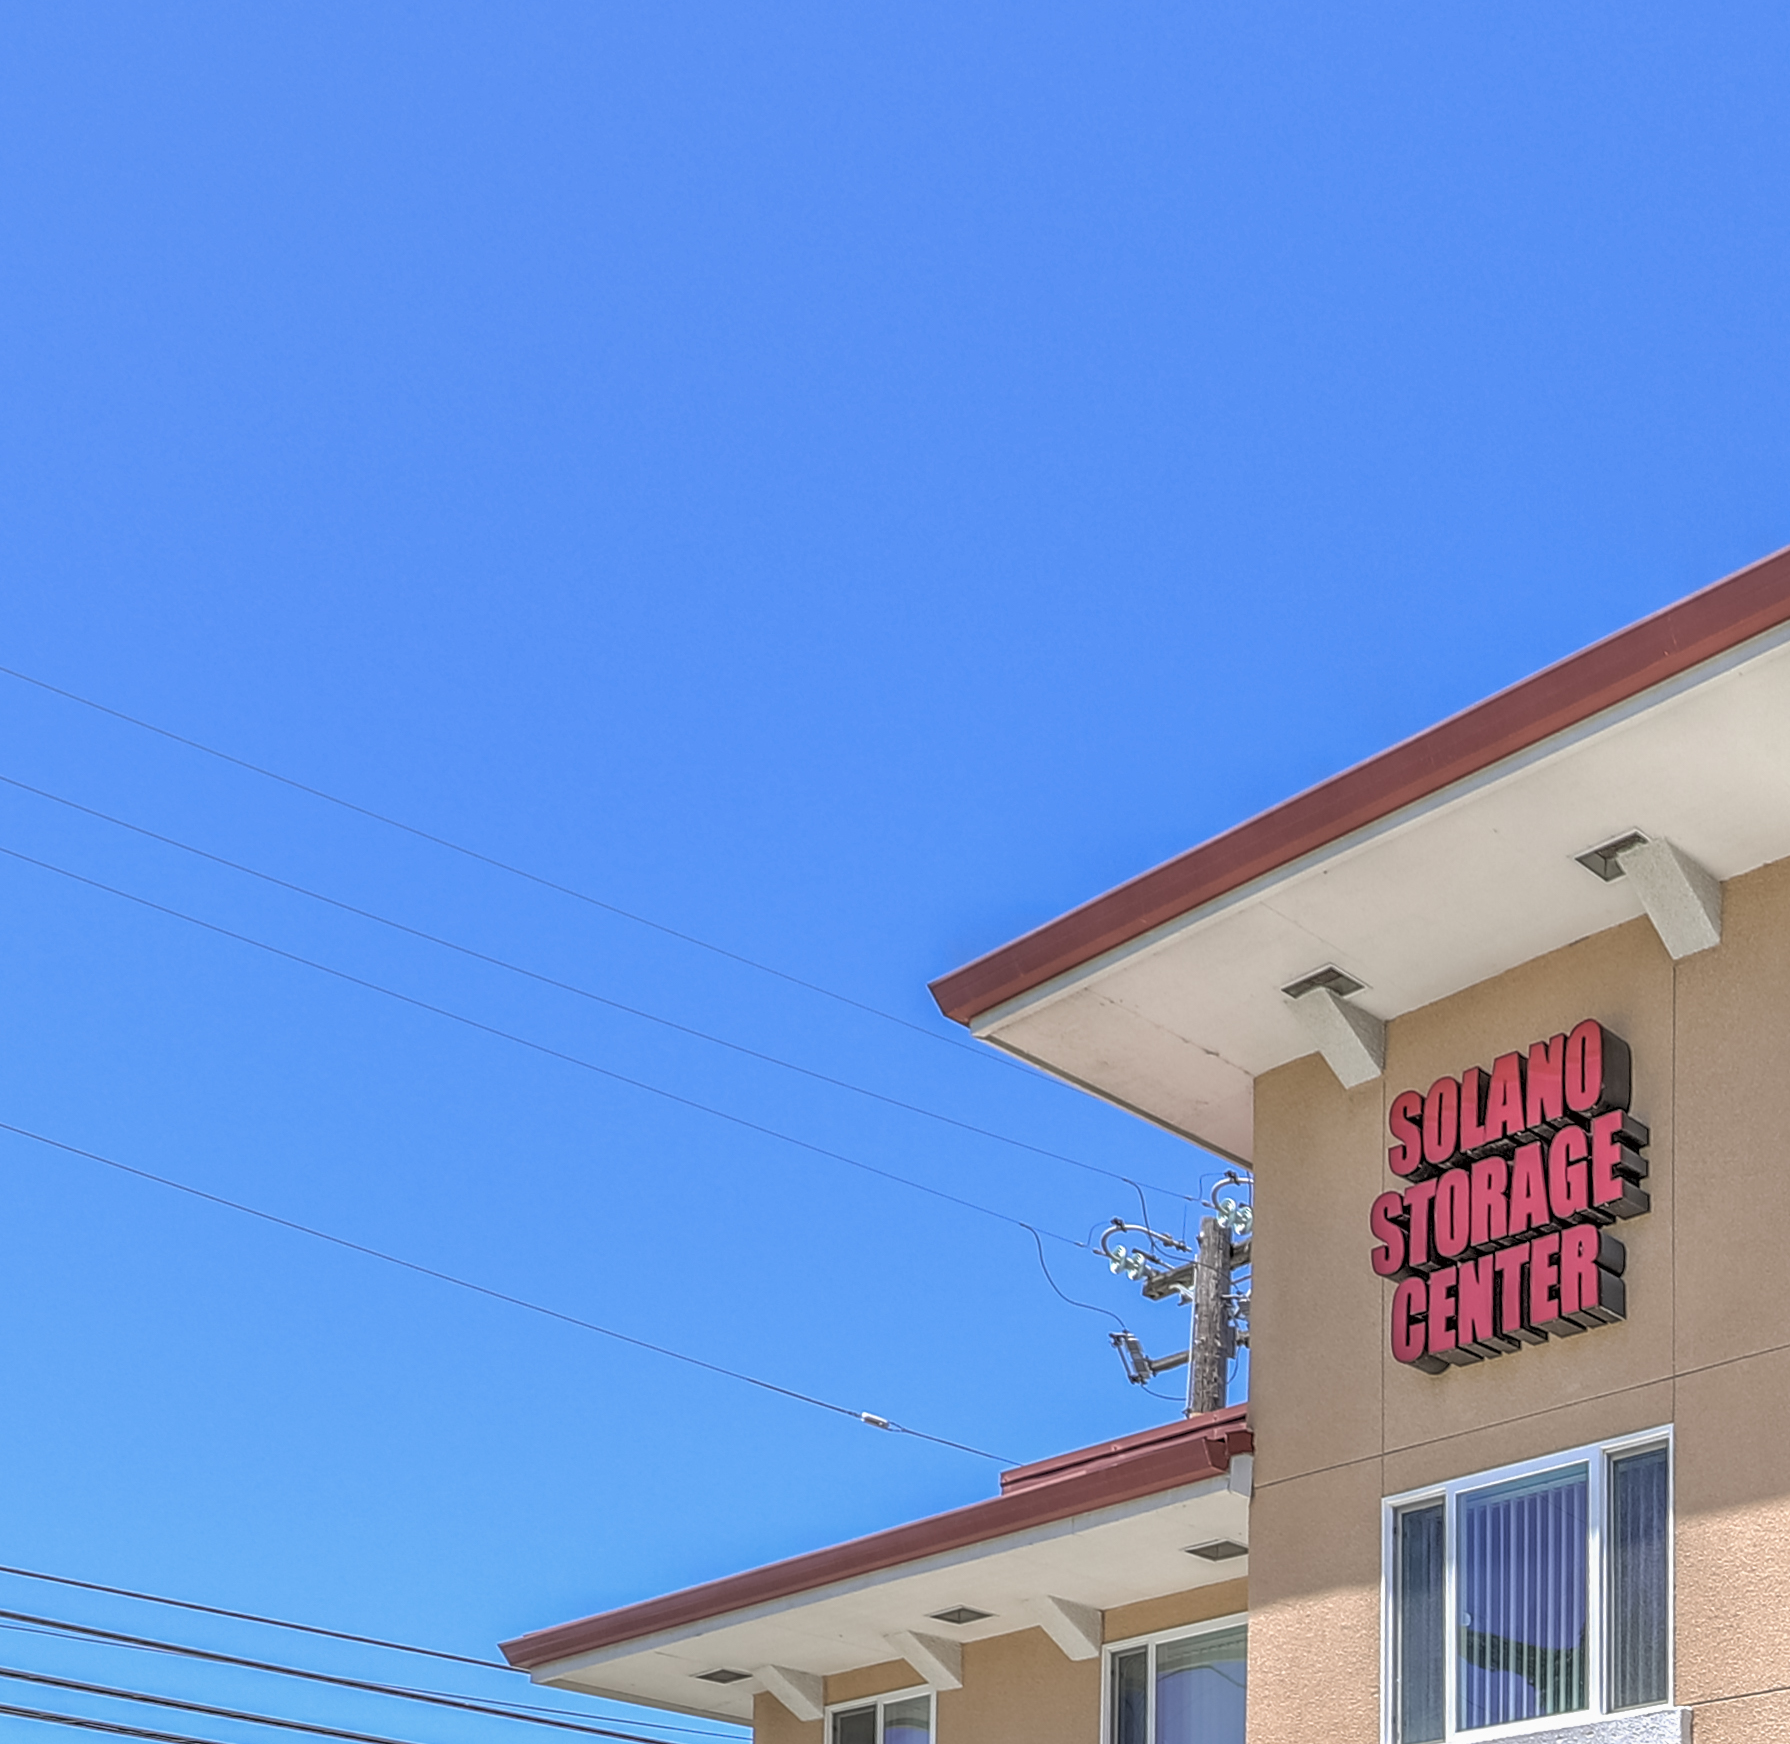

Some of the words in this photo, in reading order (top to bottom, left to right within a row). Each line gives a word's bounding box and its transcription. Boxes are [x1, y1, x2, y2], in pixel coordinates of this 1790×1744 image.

[1388, 1018, 1603, 1176] SOLANO
[1370, 1109, 1624, 1276] STORAGE
[1391, 1223, 1600, 1364] CENTER
